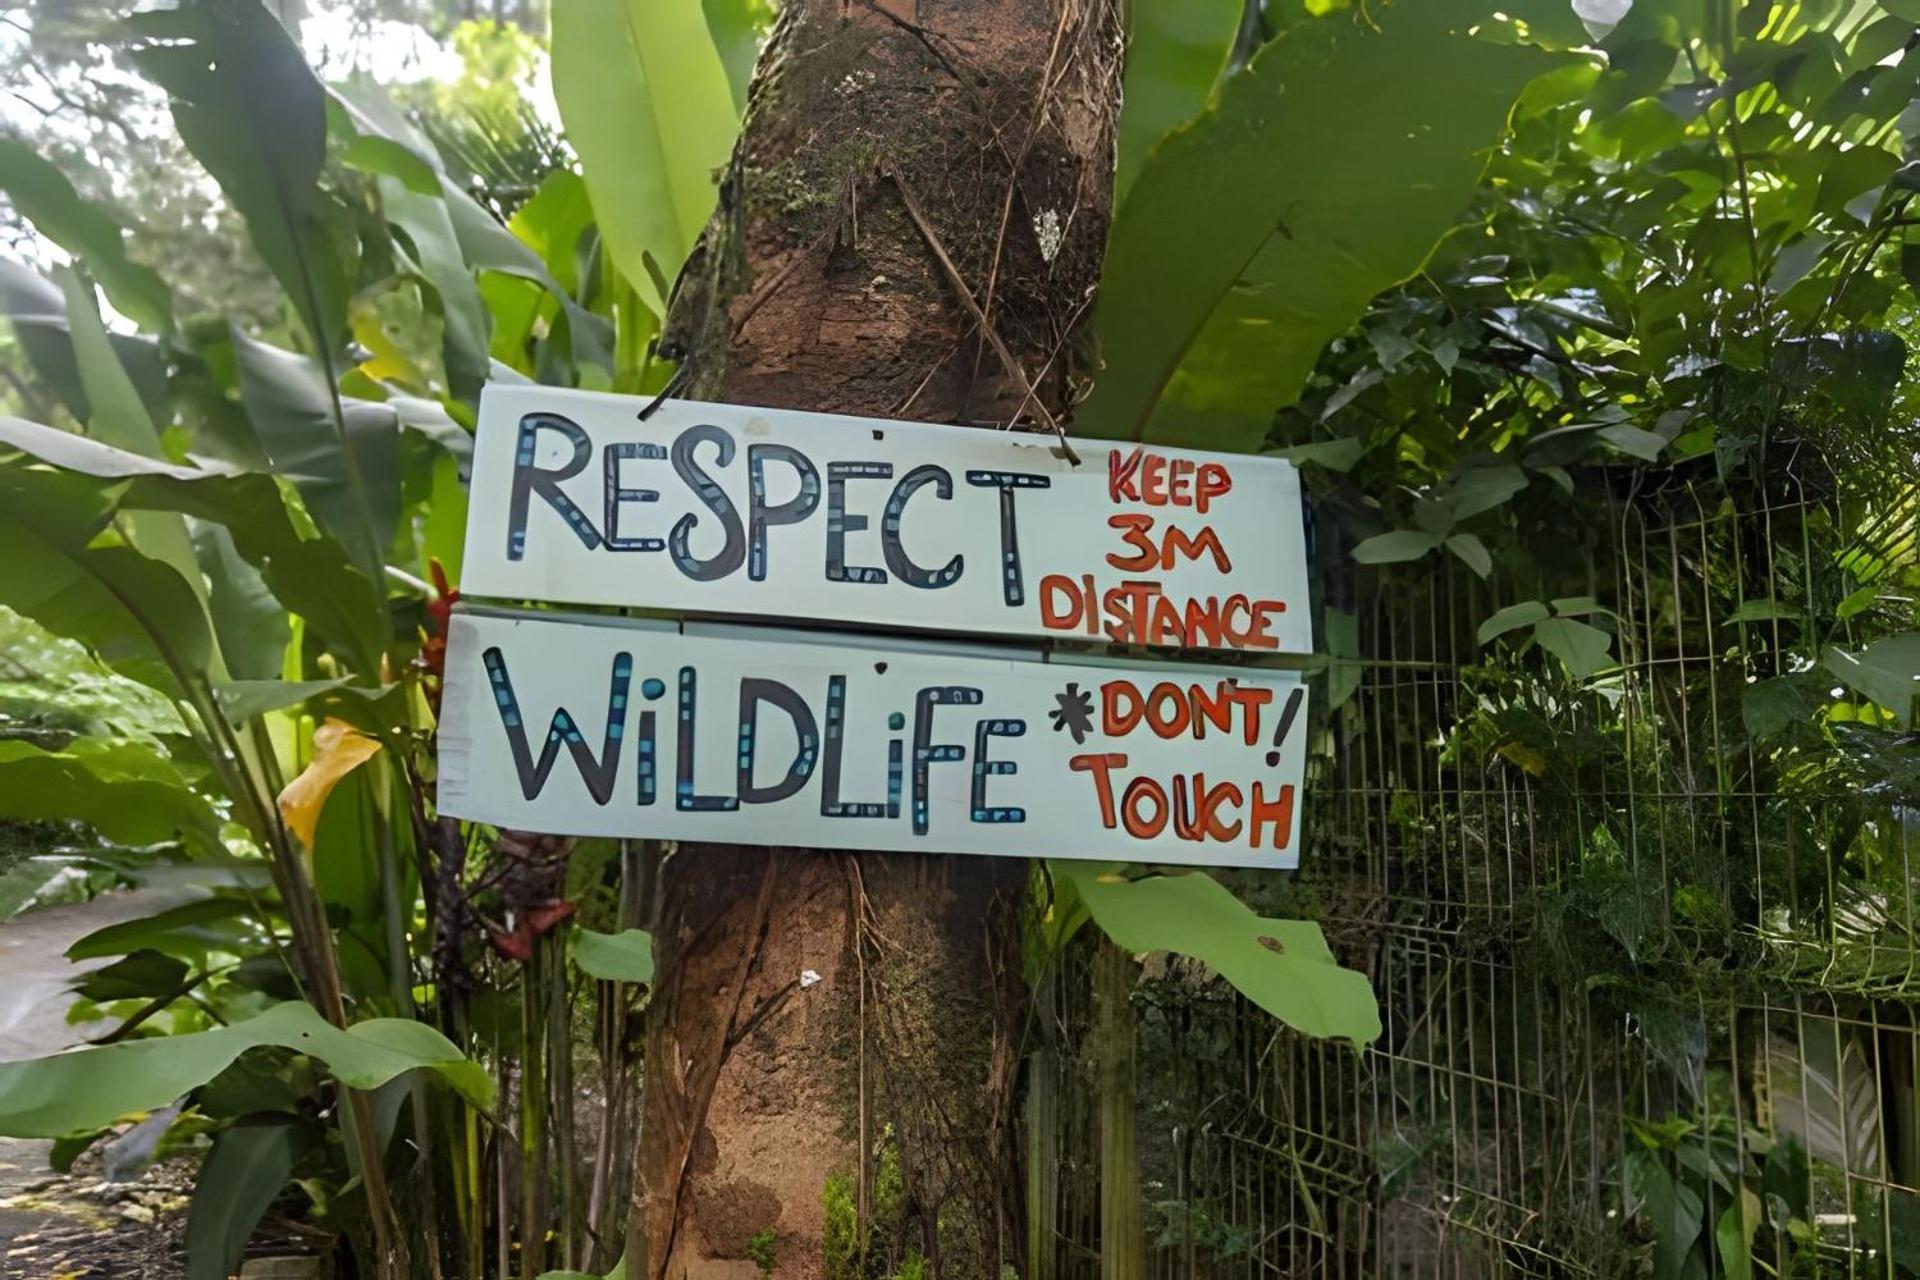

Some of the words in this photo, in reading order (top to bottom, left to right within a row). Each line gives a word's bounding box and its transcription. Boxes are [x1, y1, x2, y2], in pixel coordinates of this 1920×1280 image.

[507, 412, 1051, 607] RESPECT
[1109, 447, 1232, 514] KEEP
[1106, 514, 1232, 574] 3M
[1039, 574, 1286, 649] DISTANCE
[1069, 753, 1294, 850] TOUCH
